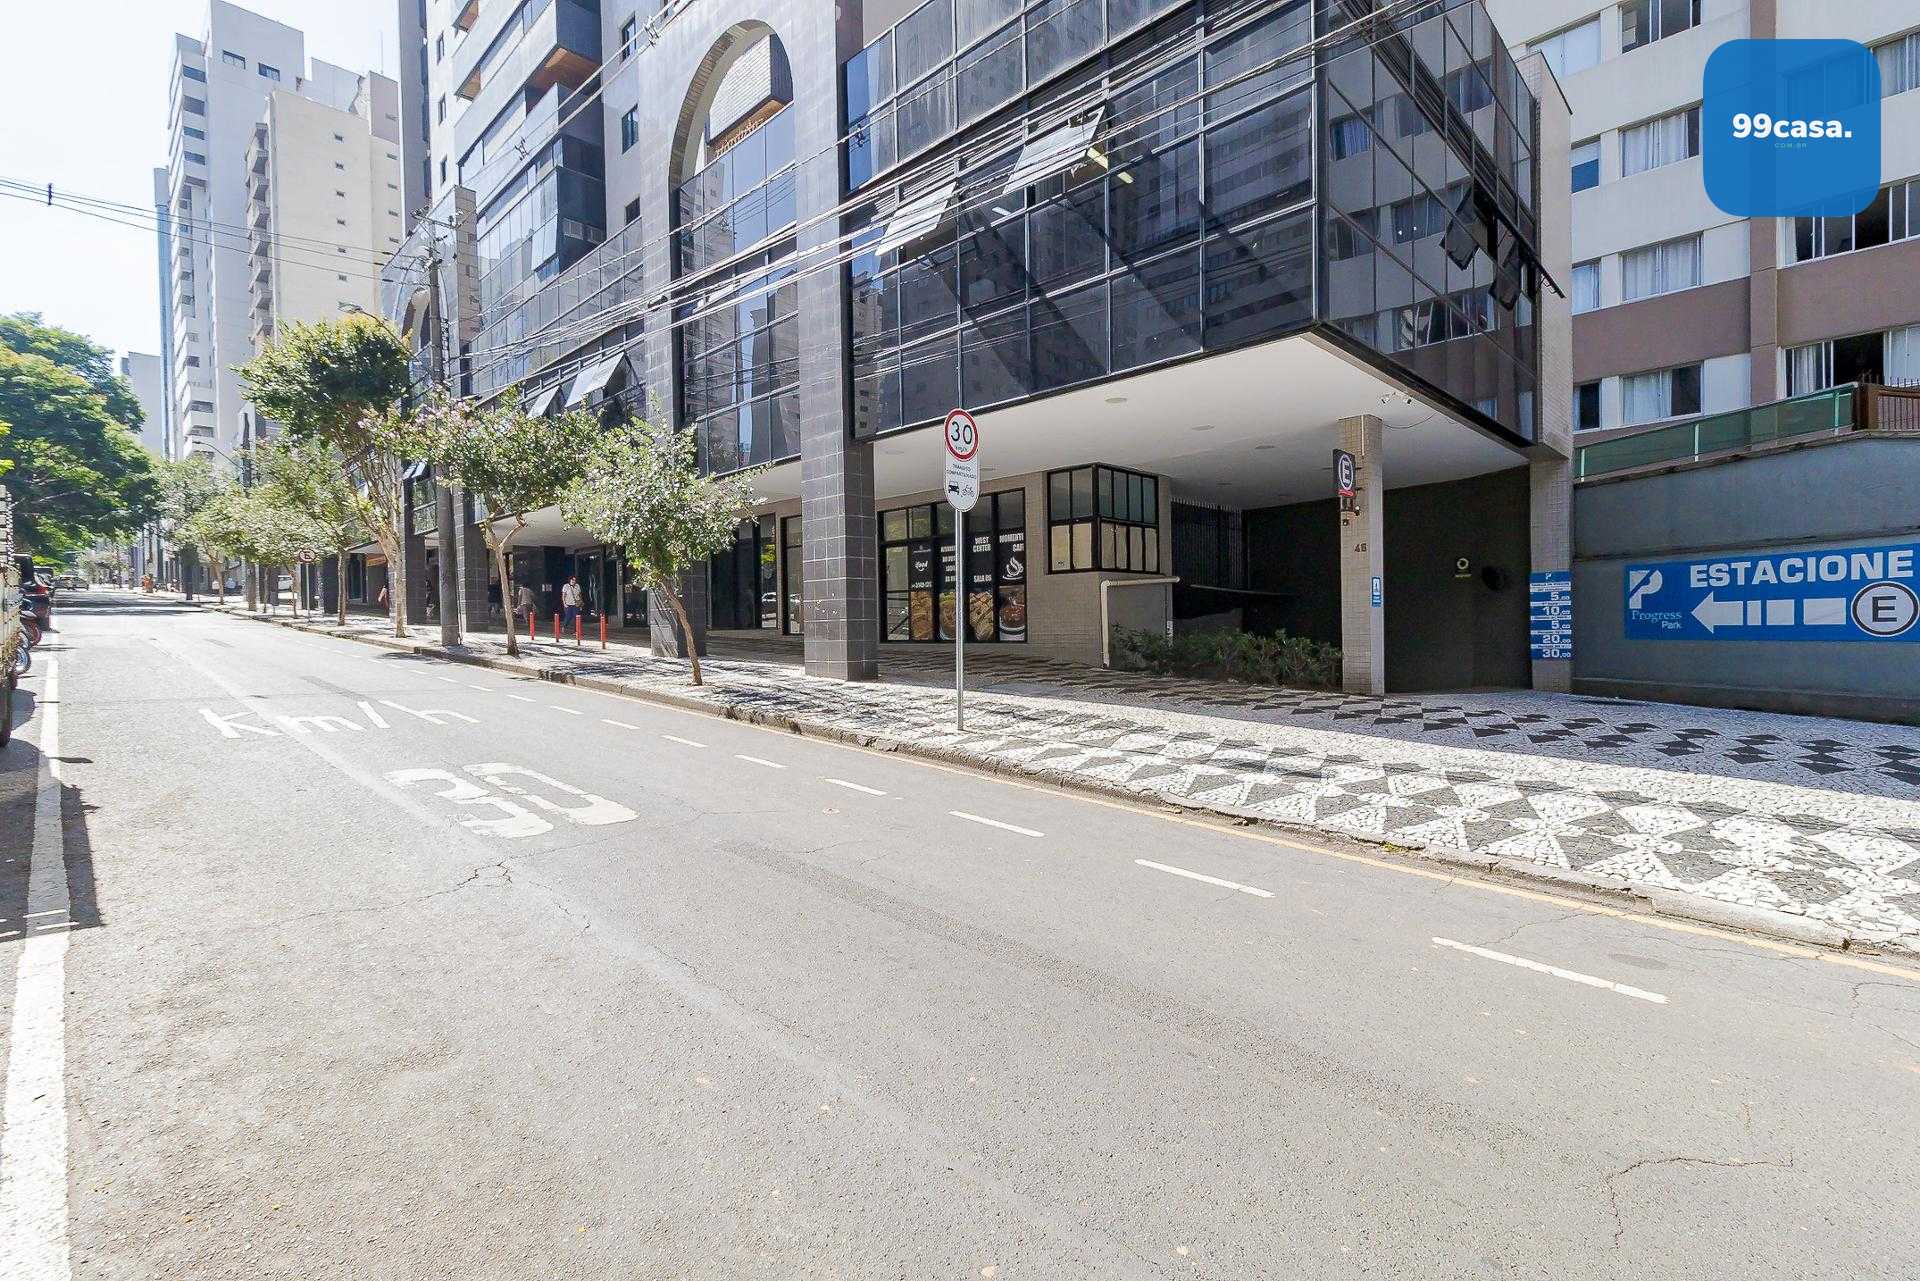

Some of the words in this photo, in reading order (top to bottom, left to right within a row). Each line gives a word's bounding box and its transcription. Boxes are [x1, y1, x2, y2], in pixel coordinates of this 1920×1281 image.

[951, 421, 973, 445] 30
[1690, 549, 1914, 588] ESTACIONE
[1631, 610, 1682, 624] Progress
[1872, 595, 1898, 623] E
[1661, 620, 1682, 630] Park
[384, 762, 640, 839] 30
